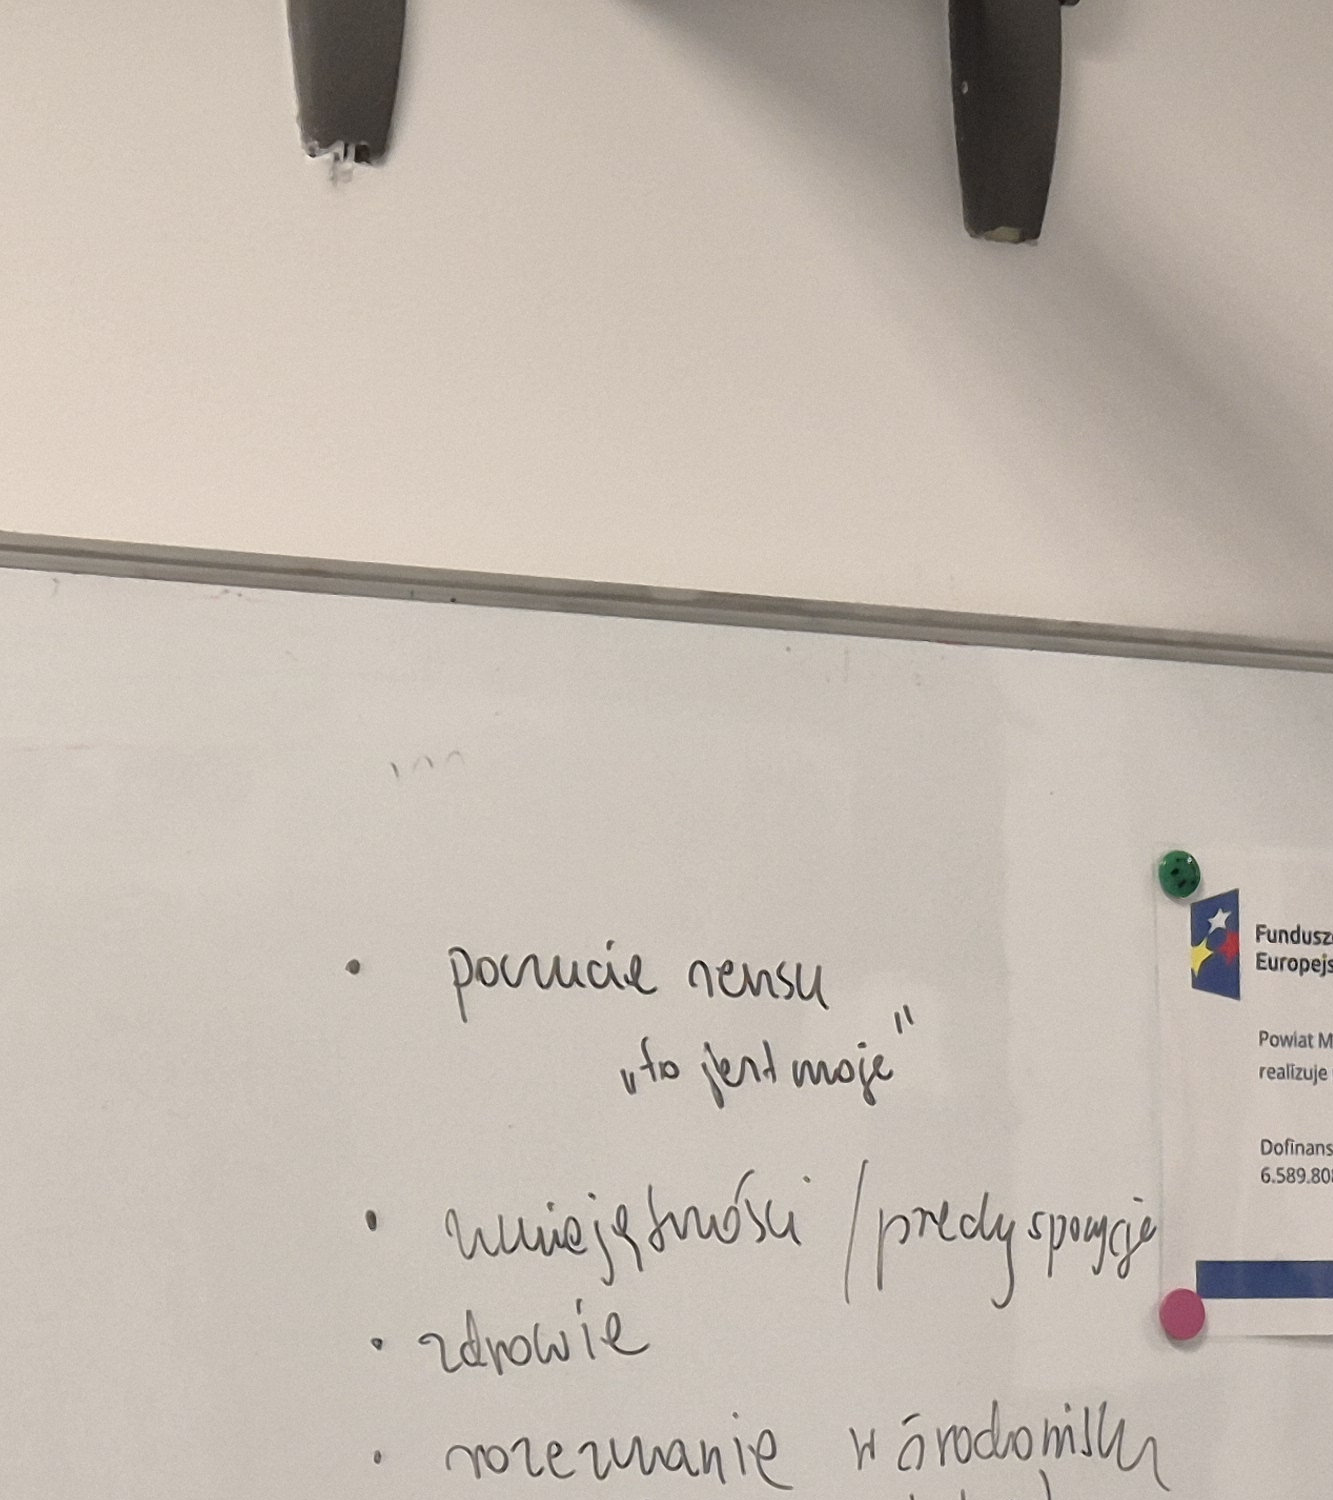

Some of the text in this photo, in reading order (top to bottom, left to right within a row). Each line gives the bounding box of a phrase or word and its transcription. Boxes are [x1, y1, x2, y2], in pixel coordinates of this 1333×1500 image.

[1258, 1030, 1314, 1049] Powiat
[1259, 1063, 1328, 1085] realizuje
[417, 1298, 649, 1376] zdrowie
